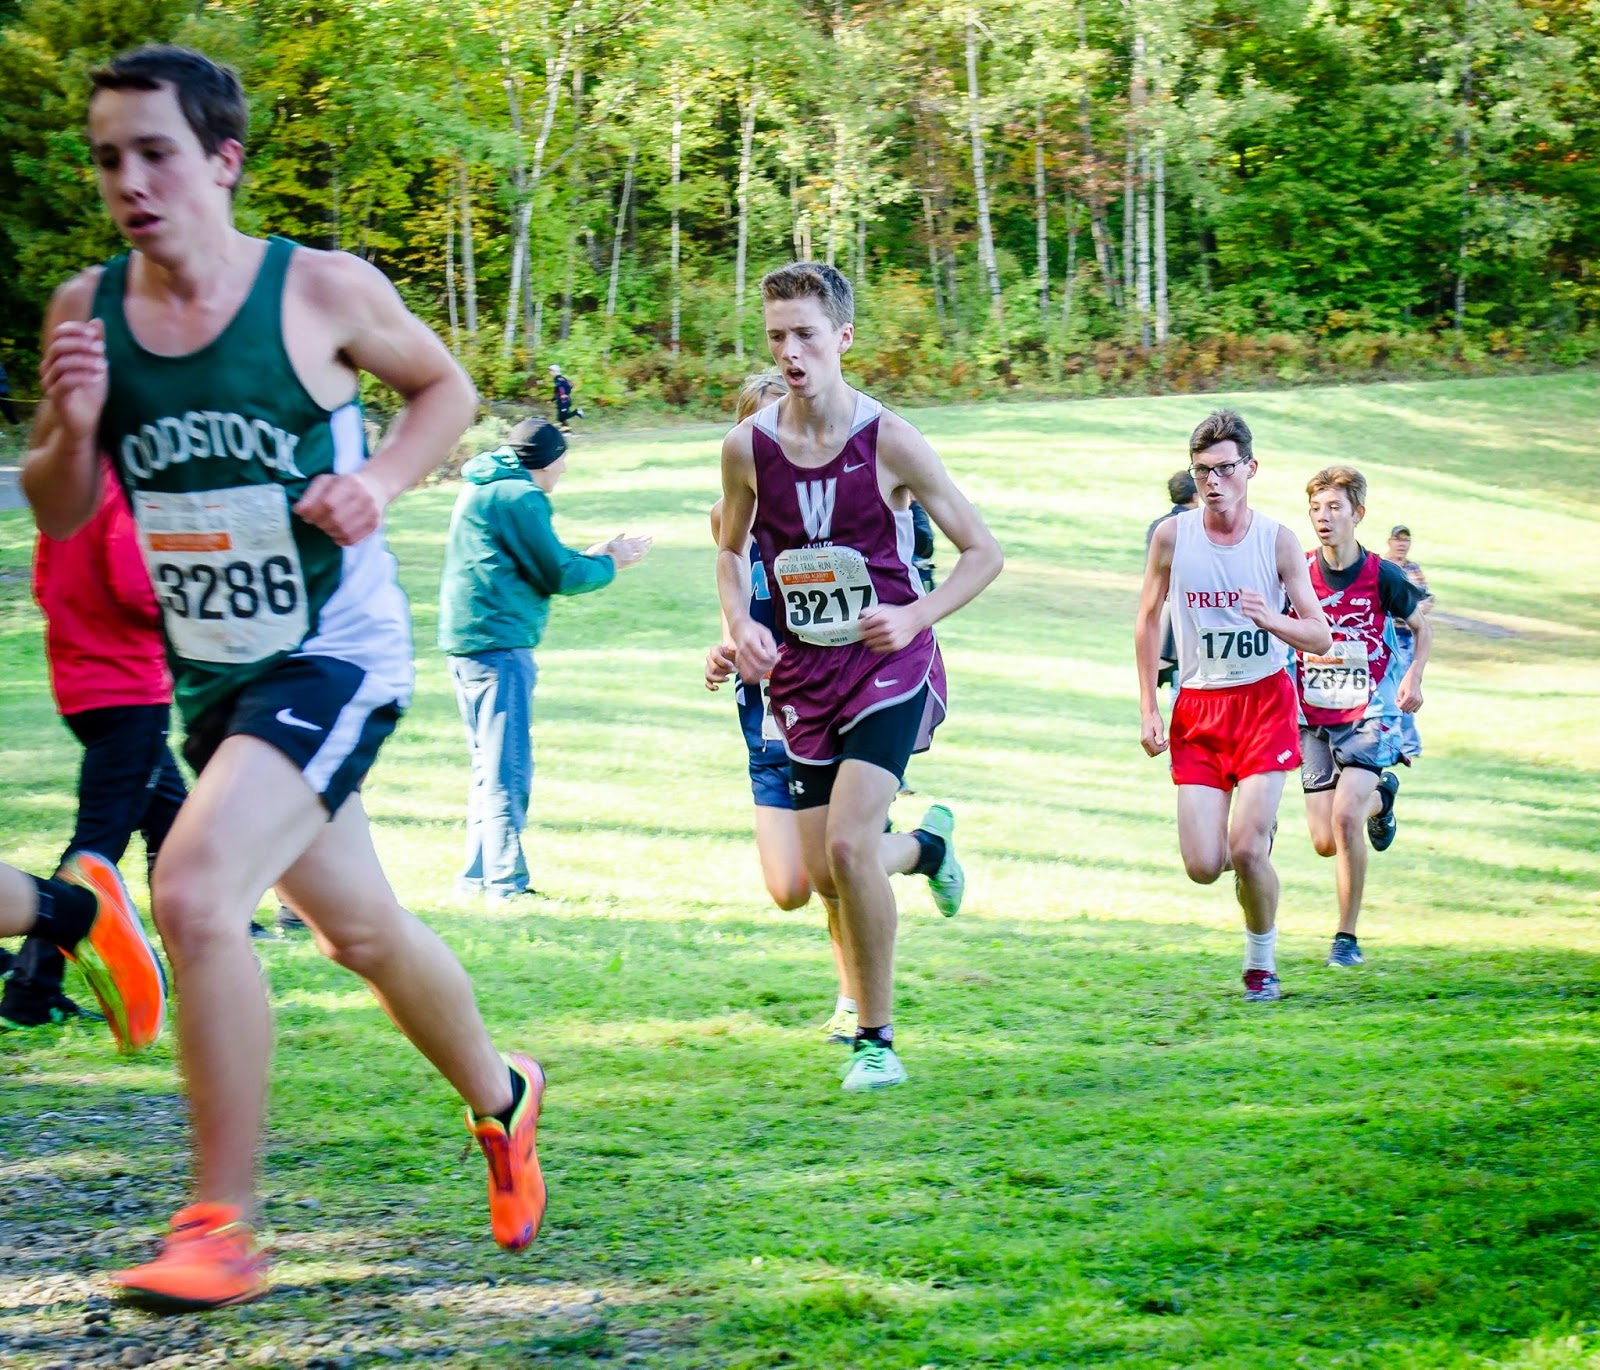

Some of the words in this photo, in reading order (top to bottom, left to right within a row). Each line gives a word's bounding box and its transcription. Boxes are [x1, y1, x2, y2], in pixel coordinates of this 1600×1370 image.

[122, 410, 307, 479] OODSTOCK
[796, 477, 837, 542] W
[779, 564, 799, 573] WOODS
[800, 563, 815, 571] TRAIL
[818, 561, 832, 570] RUN
[158, 555, 298, 620] 3286
[1186, 591, 1240, 609] PREP
[786, 585, 873, 627] 3217
[1201, 629, 1269, 660] 1760
[1307, 668, 1367, 690] 2376
